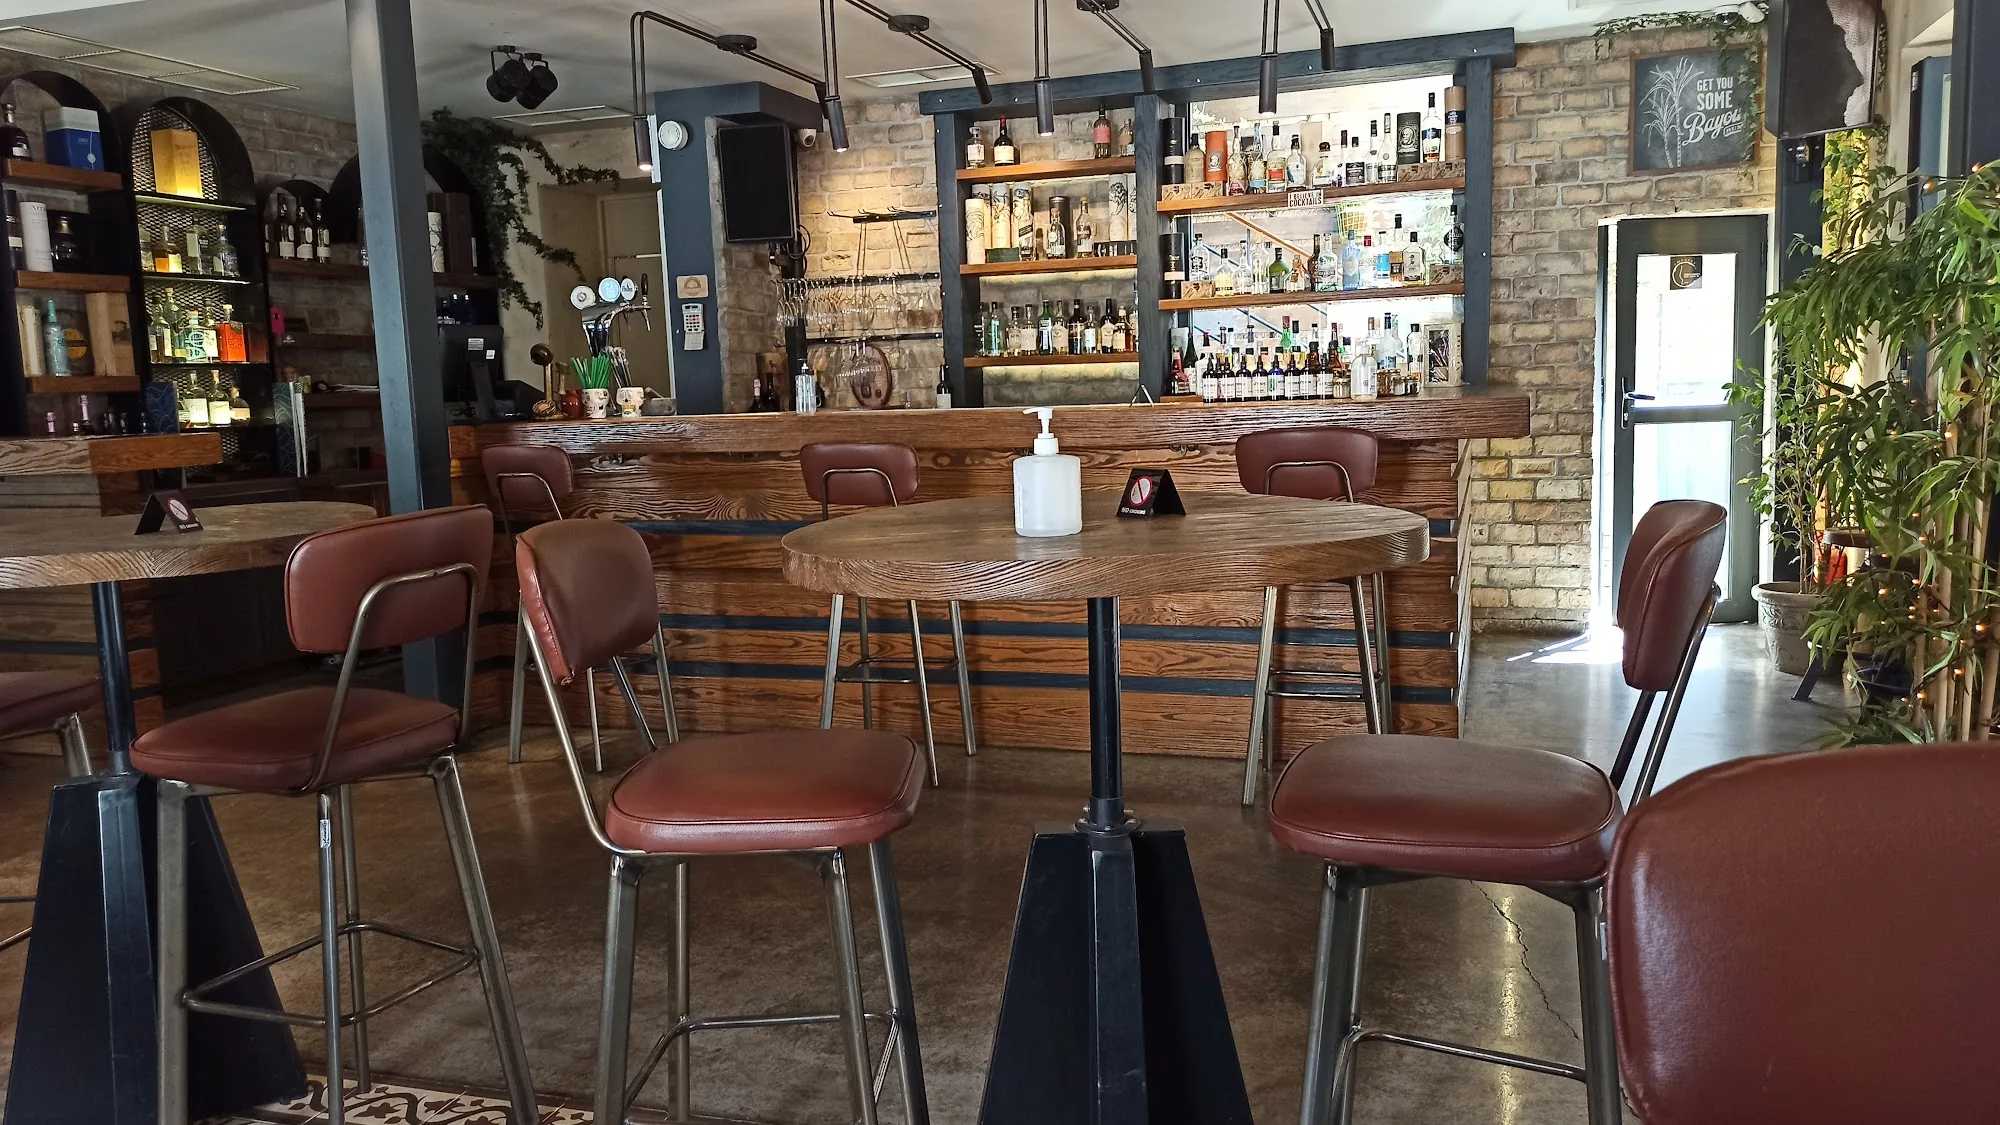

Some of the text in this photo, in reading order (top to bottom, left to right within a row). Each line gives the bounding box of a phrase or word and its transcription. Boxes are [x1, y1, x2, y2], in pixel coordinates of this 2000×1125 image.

[1697, 76, 1733, 91] GET YOU
[1697, 90, 1733, 111] SOME
[1293, 191, 1314, 200] BELIEVE
[1289, 197, 1322, 207] COCKTAILS
